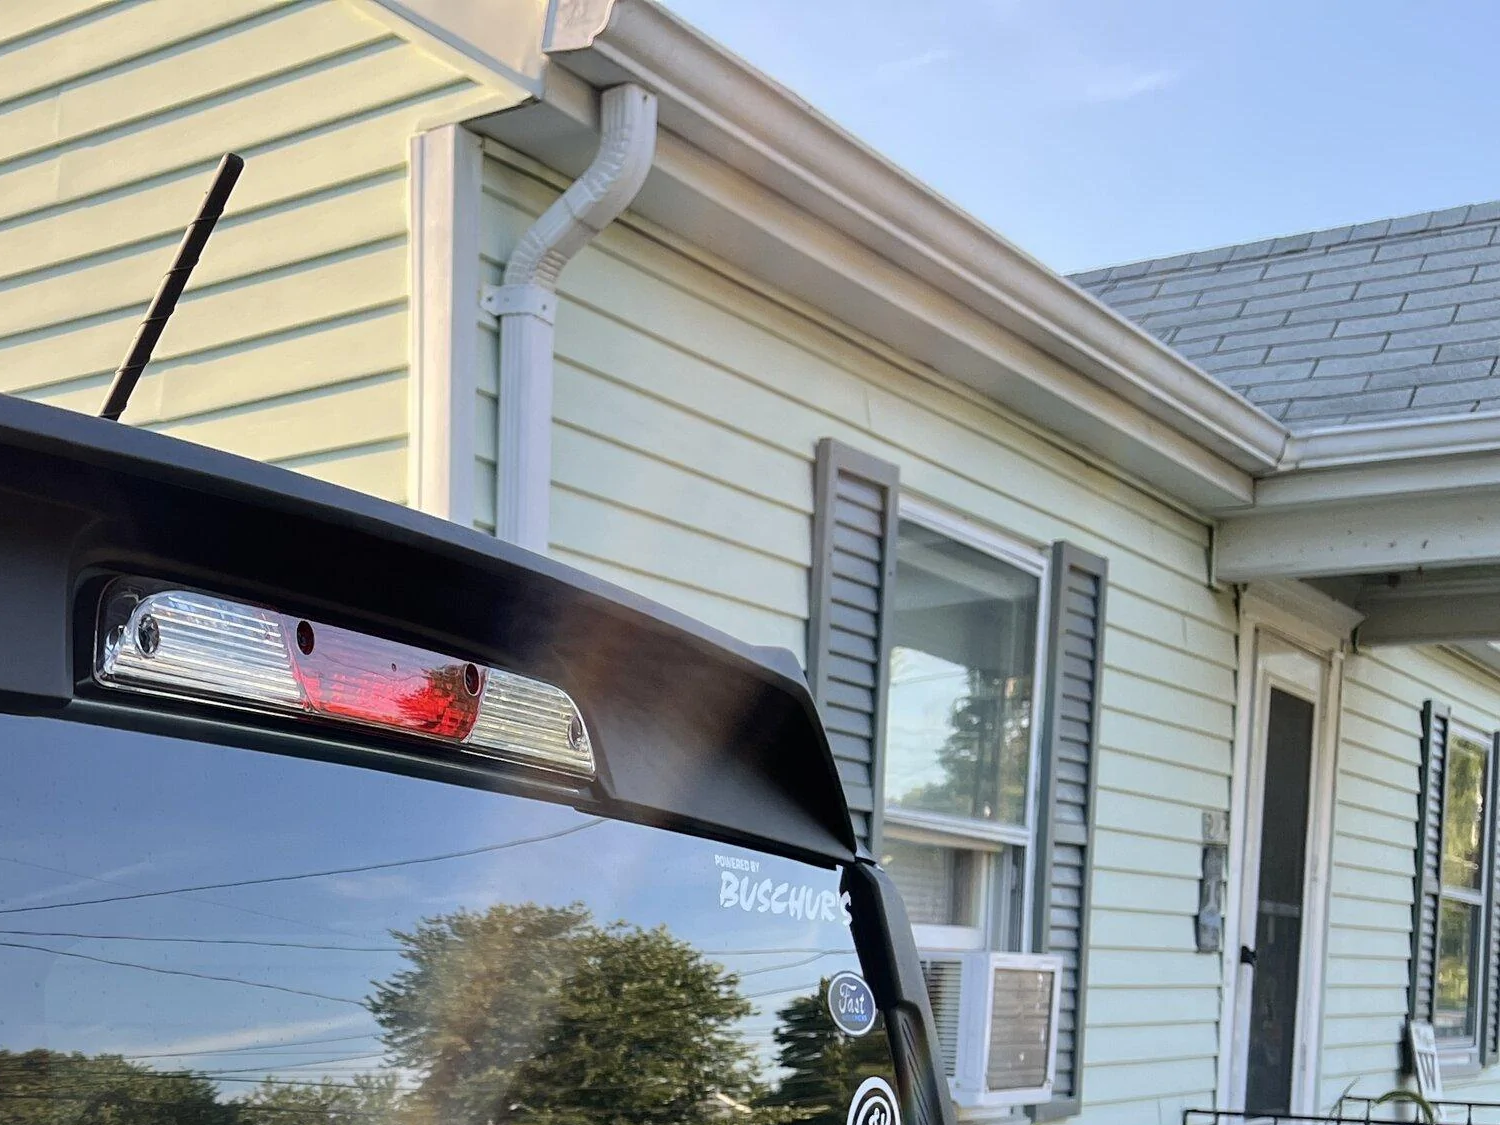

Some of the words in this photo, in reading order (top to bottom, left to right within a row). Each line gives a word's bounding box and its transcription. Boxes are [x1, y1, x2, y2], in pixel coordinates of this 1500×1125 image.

[713, 854, 749, 871] POWERED
[749, 860, 761, 873] BY
[838, 982, 865, 1015] Fast
